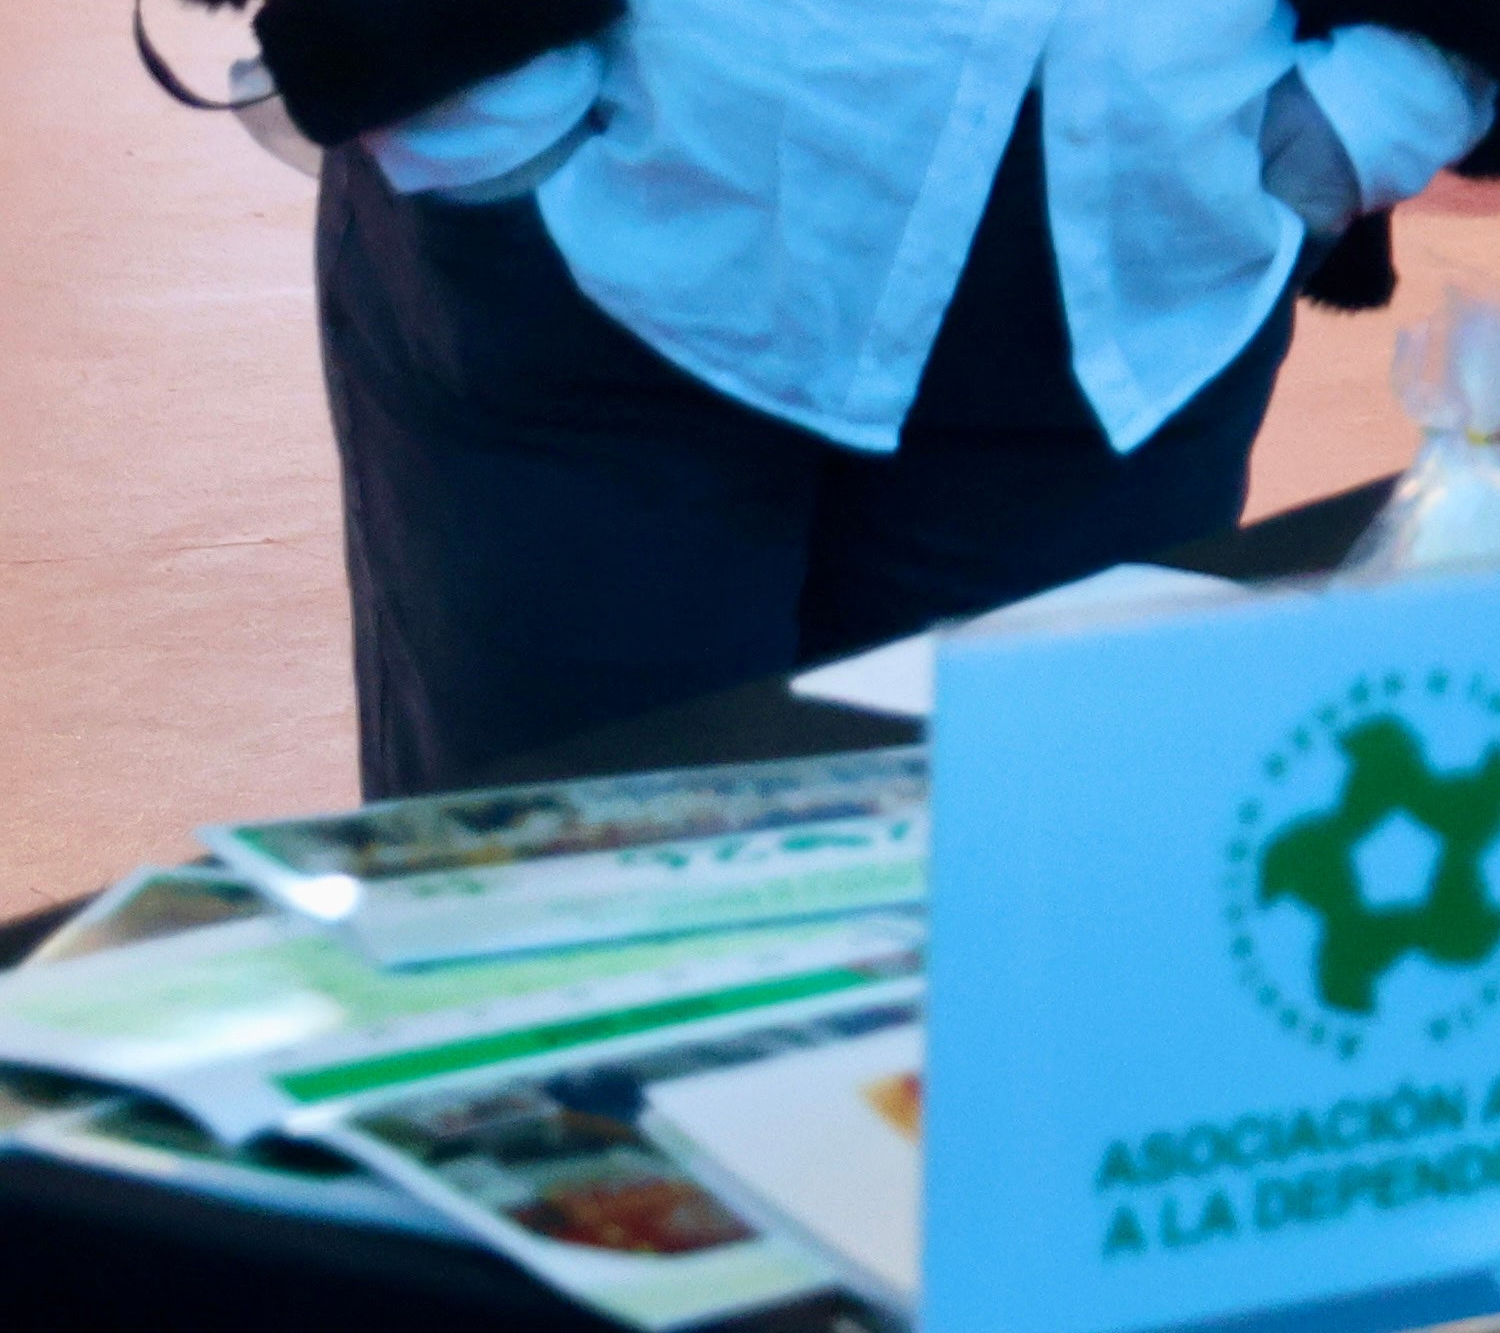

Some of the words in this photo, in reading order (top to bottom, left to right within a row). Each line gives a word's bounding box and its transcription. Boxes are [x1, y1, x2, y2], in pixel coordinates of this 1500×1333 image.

[1099, 1081, 1467, 1188] ASOCIACIÓN
[1102, 1205, 1147, 1257] A
[1159, 1189, 1237, 1249] LA
